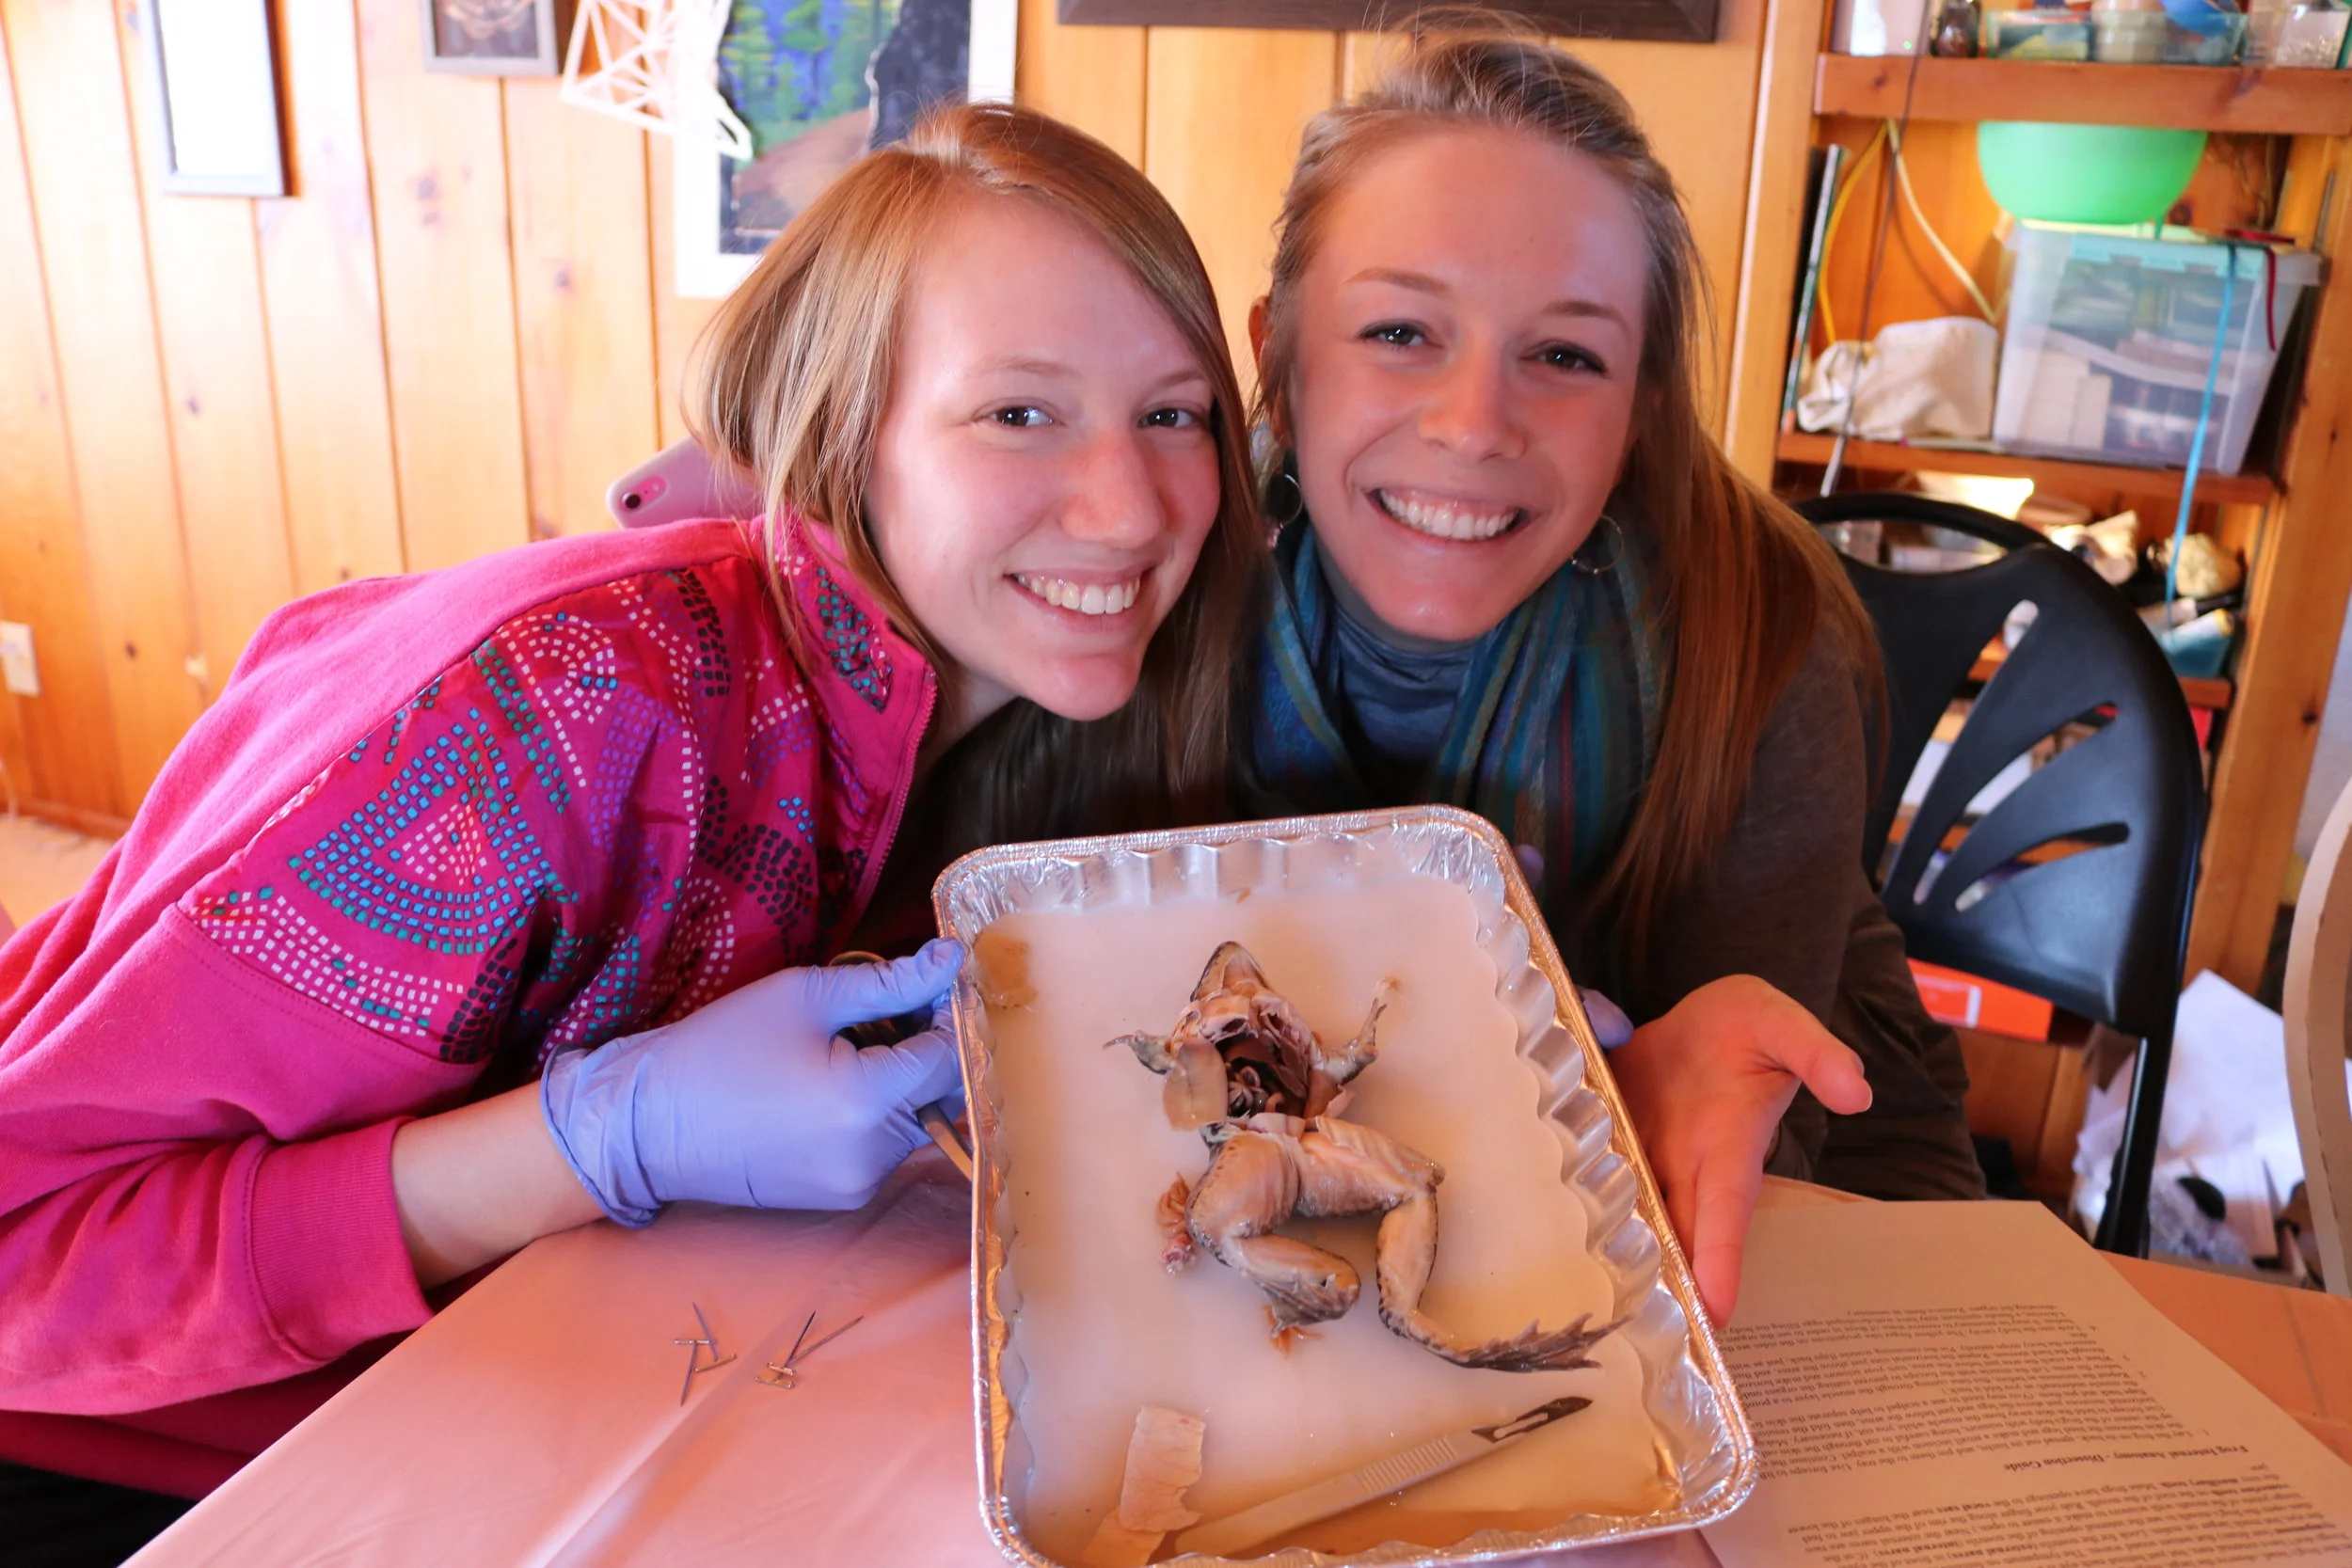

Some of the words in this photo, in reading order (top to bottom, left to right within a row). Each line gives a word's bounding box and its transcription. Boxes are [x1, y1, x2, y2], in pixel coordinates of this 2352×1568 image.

[1763, 1385, 1797, 1395] organs
[1793, 1392, 1820, 1403] layer
[1742, 1398, 1770, 1409] point
[1788, 1415, 1805, 1424] the
[1805, 1408, 1849, 1421] separate
[1763, 1418, 1787, 1428] skin
[1809, 1423, 1832, 1433] fold
[1833, 1420, 1856, 1430] then
[1790, 1426, 1809, 1434] the
[1803, 1444, 1820, 1453] the
[1820, 1437, 1863, 1451] through
[2216, 1444, 2249, 1454] Frog
[1756, 1449, 1776, 1459] onl
[1779, 1447, 1802, 1456] skin
[2112, 1449, 2166, 1461] Anatomy
[2168, 1449, 2217, 1458] Internal
[1768, 1459, 1787, 1468] the
[1788, 1453, 1837, 1466] Continue
[1878, 1457, 1896, 1466] the
[2043, 1454, 2104, 1467] Dissection
[1788, 1464, 1828, 1477] forceps
[1829, 1463, 1851, 1473] Use
[2003, 1460, 2042, 1472] Guide
[1758, 1471, 1773, 1481] lift
[1774, 1469, 1788, 1479] to
[1891, 1512, 1910, 1522] the
[1911, 1508, 1934, 1517] near
[1839, 1519, 1852, 1528] of
[1852, 1513, 1891, 1527] hinges
[1927, 1518, 1948, 1528] rim
[1948, 1516, 1968, 1526] the
[1787, 1523, 1820, 1535] lower
[1820, 1521, 1839, 1531] the
[1860, 1523, 1892, 1534] upper
[1893, 1523, 1913, 1532] the
[1824, 1531, 1837, 1541] to
[1837, 1527, 1858, 1537] jaw
[1923, 1530, 1943, 1541] the
[1801, 1533, 1822, 1544] feel
[1848, 1539, 1878, 1548] nares
[1879, 1533, 1923, 1546] internal
[1804, 1544, 1828, 1556] two
[1828, 1542, 1846, 1550] are
[1911, 1537, 1964, 1554] (internal
[1841, 1548, 1869, 1562] (Cut
[1946, 1546, 1985, 1561] nares)
[1822, 1554, 1842, 1565] the
[1888, 1559, 1903, 1568] of
[1903, 1555, 1932, 1567] front
